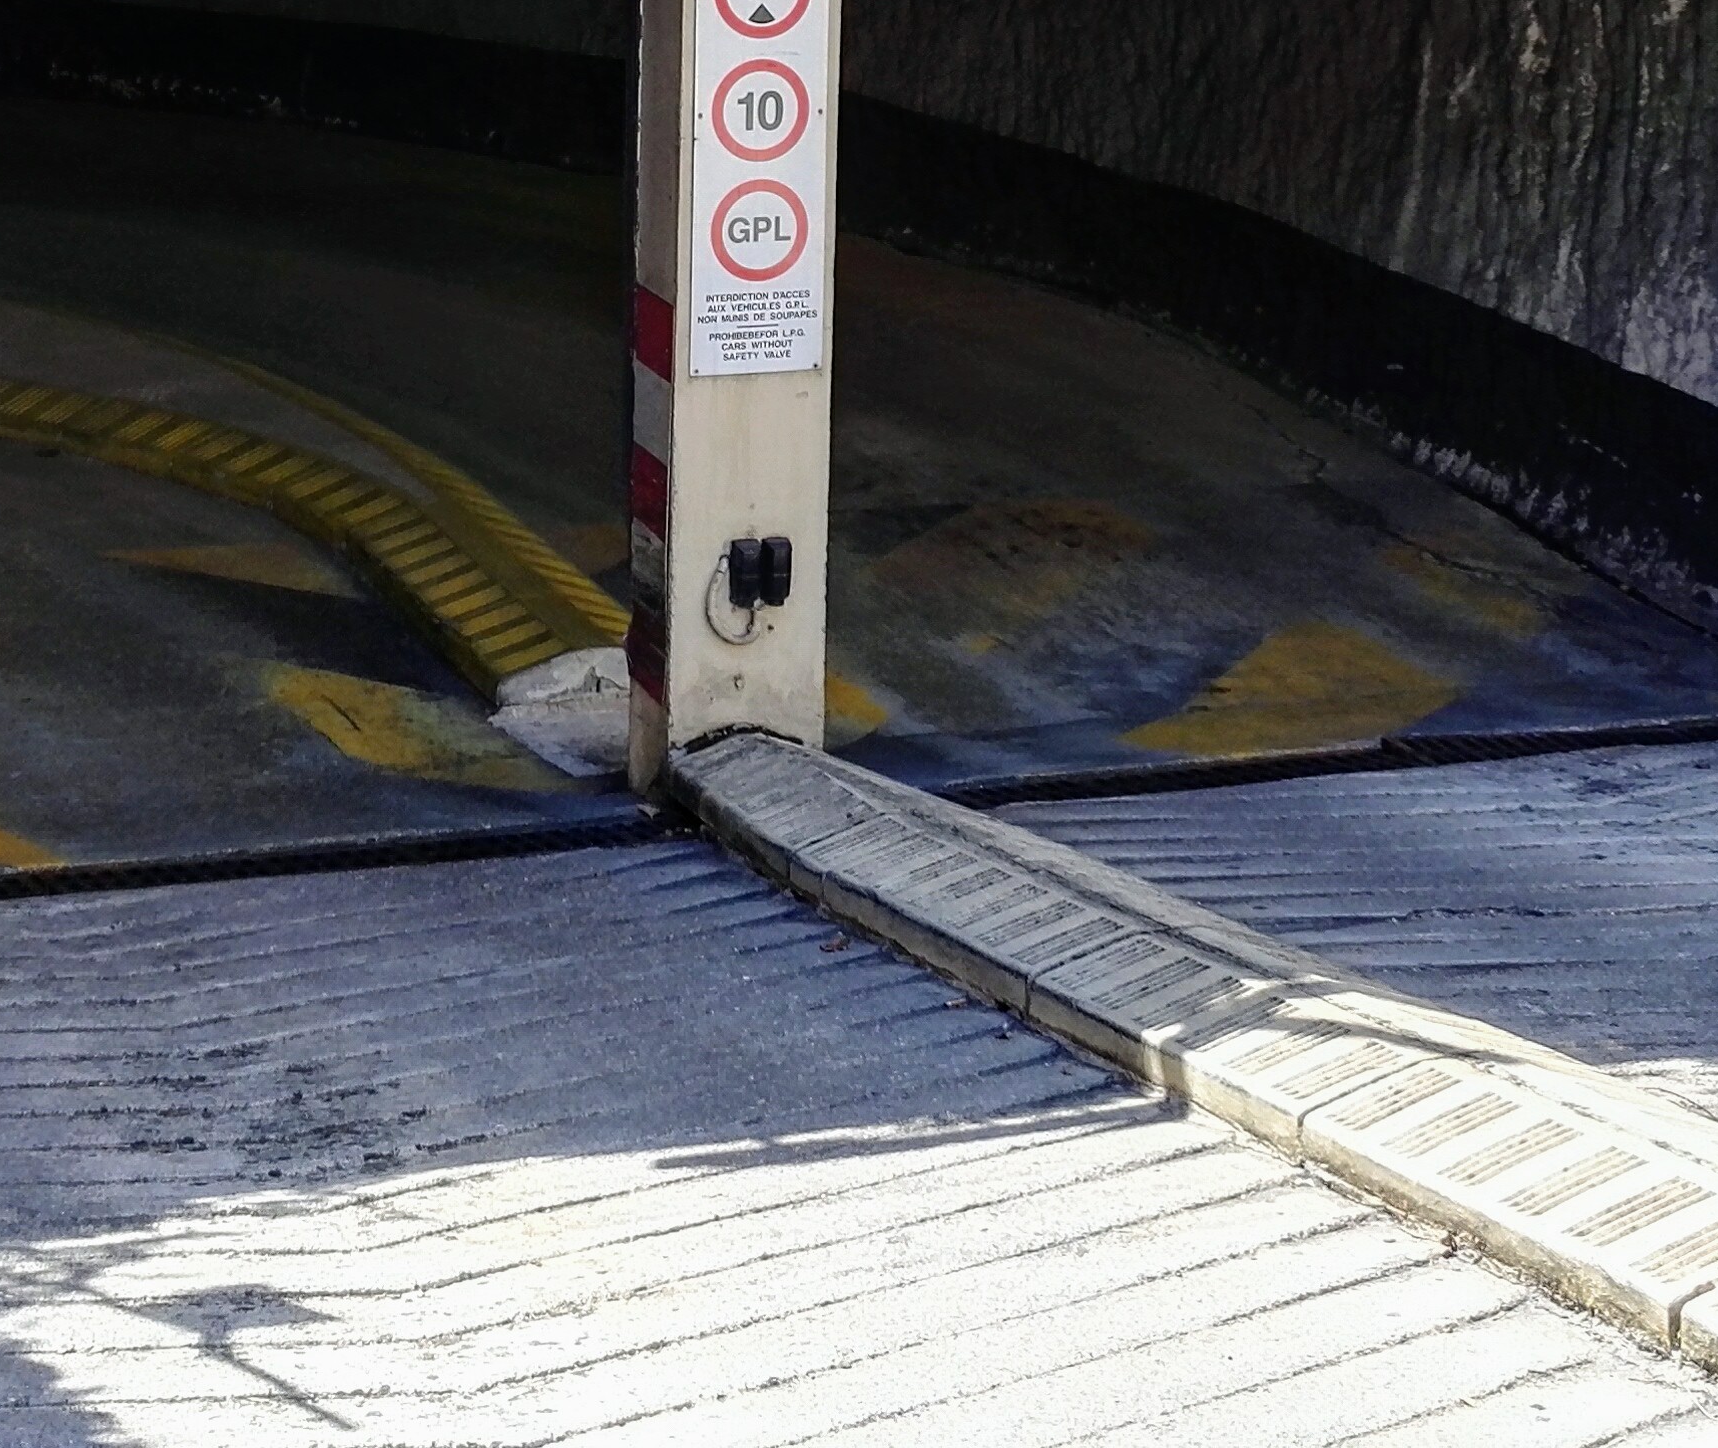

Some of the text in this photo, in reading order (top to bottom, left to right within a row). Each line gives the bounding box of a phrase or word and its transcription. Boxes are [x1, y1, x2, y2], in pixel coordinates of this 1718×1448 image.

[736, 90, 785, 132] 10
[727, 216, 792, 244] GPL
[705, 292, 769, 303] INTERDICTION
[707, 304, 726, 313] AUX
[732, 301, 781, 312] VEHICULES
[697, 309, 818, 324] NON MUNIS DE SOUPAPES
[721, 339, 793, 351] CARS WITHOUT
[723, 349, 792, 362] SAFETY VALVE
